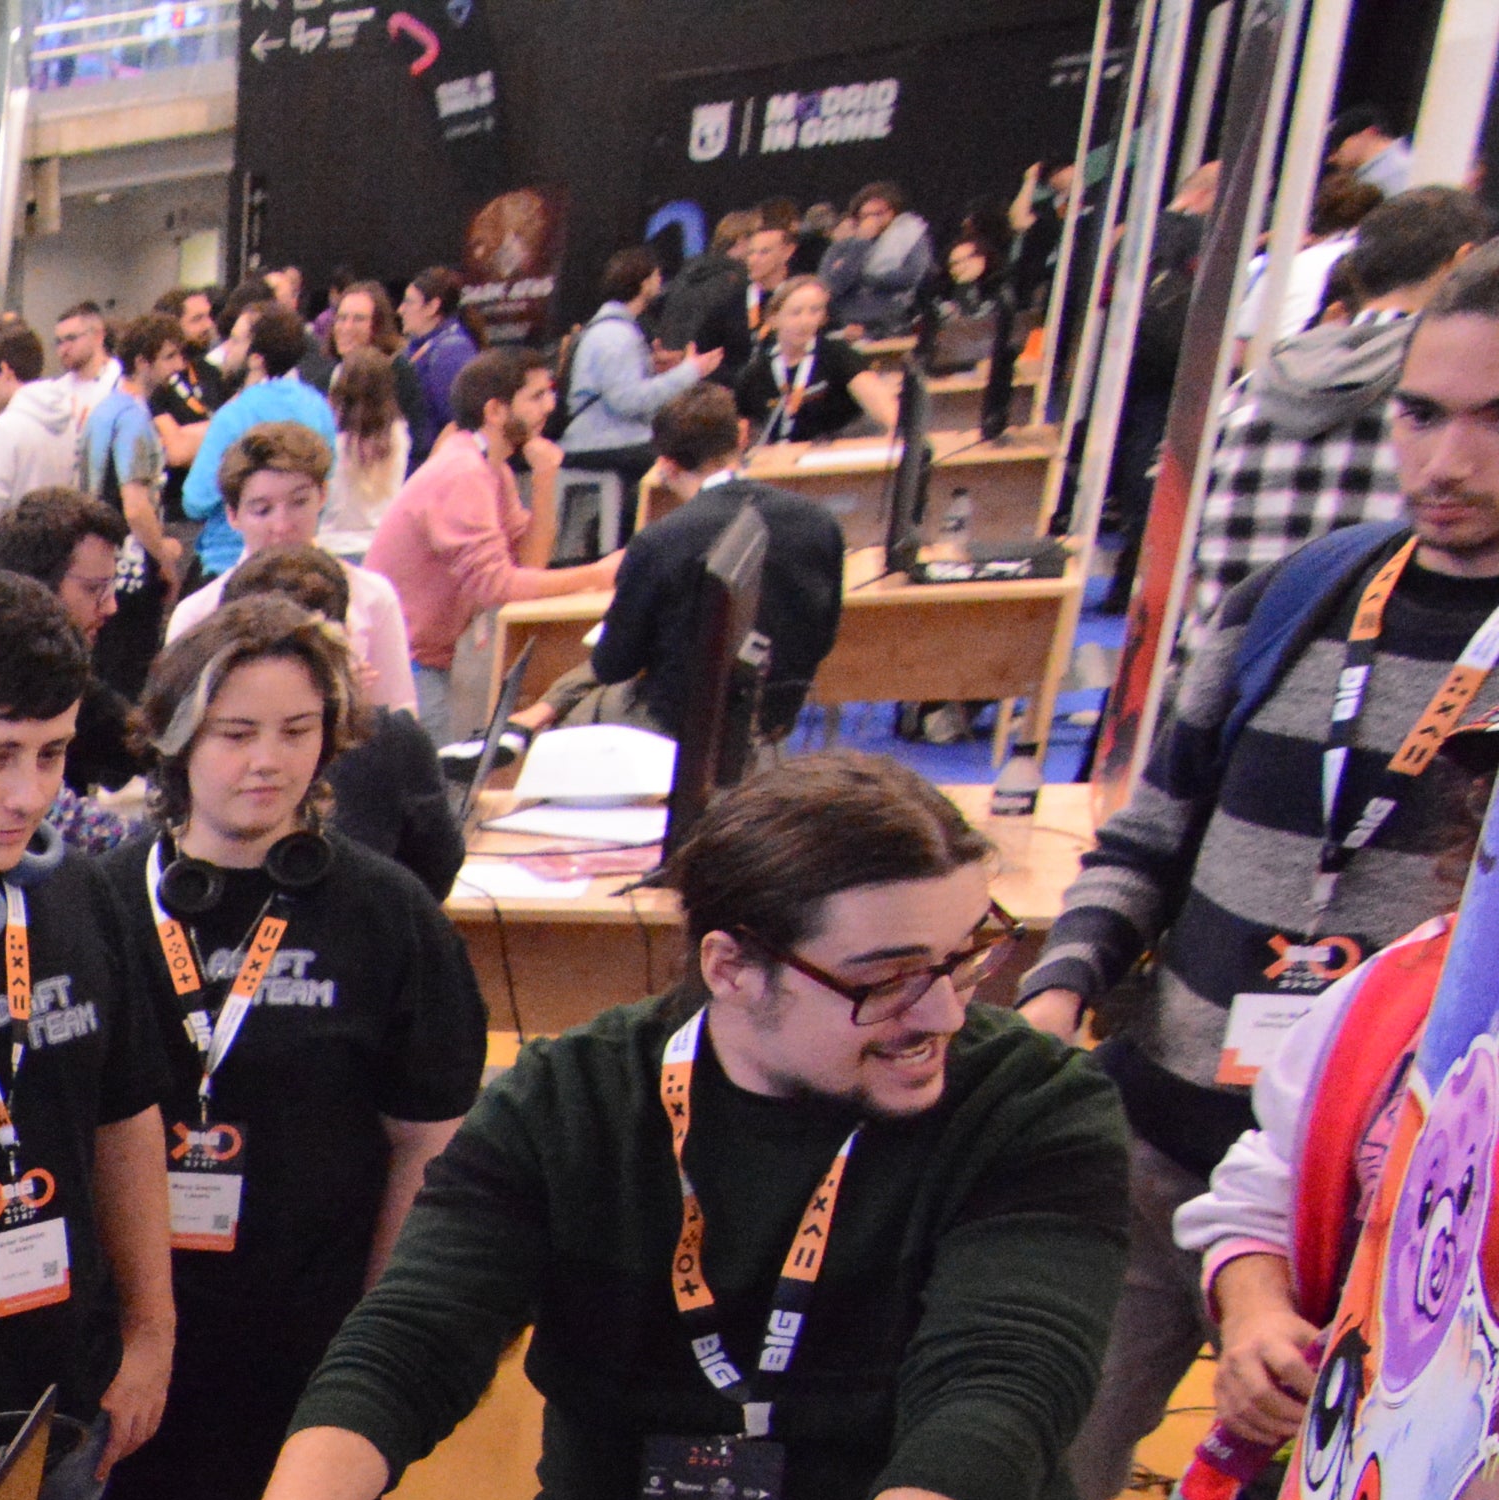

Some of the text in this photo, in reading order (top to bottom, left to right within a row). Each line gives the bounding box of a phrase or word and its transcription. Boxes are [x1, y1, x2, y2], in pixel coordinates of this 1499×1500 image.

[28, 1001, 99, 1050] TEAM
[691, 1333, 742, 1389] BIG
[758, 1309, 802, 1371] BIG
